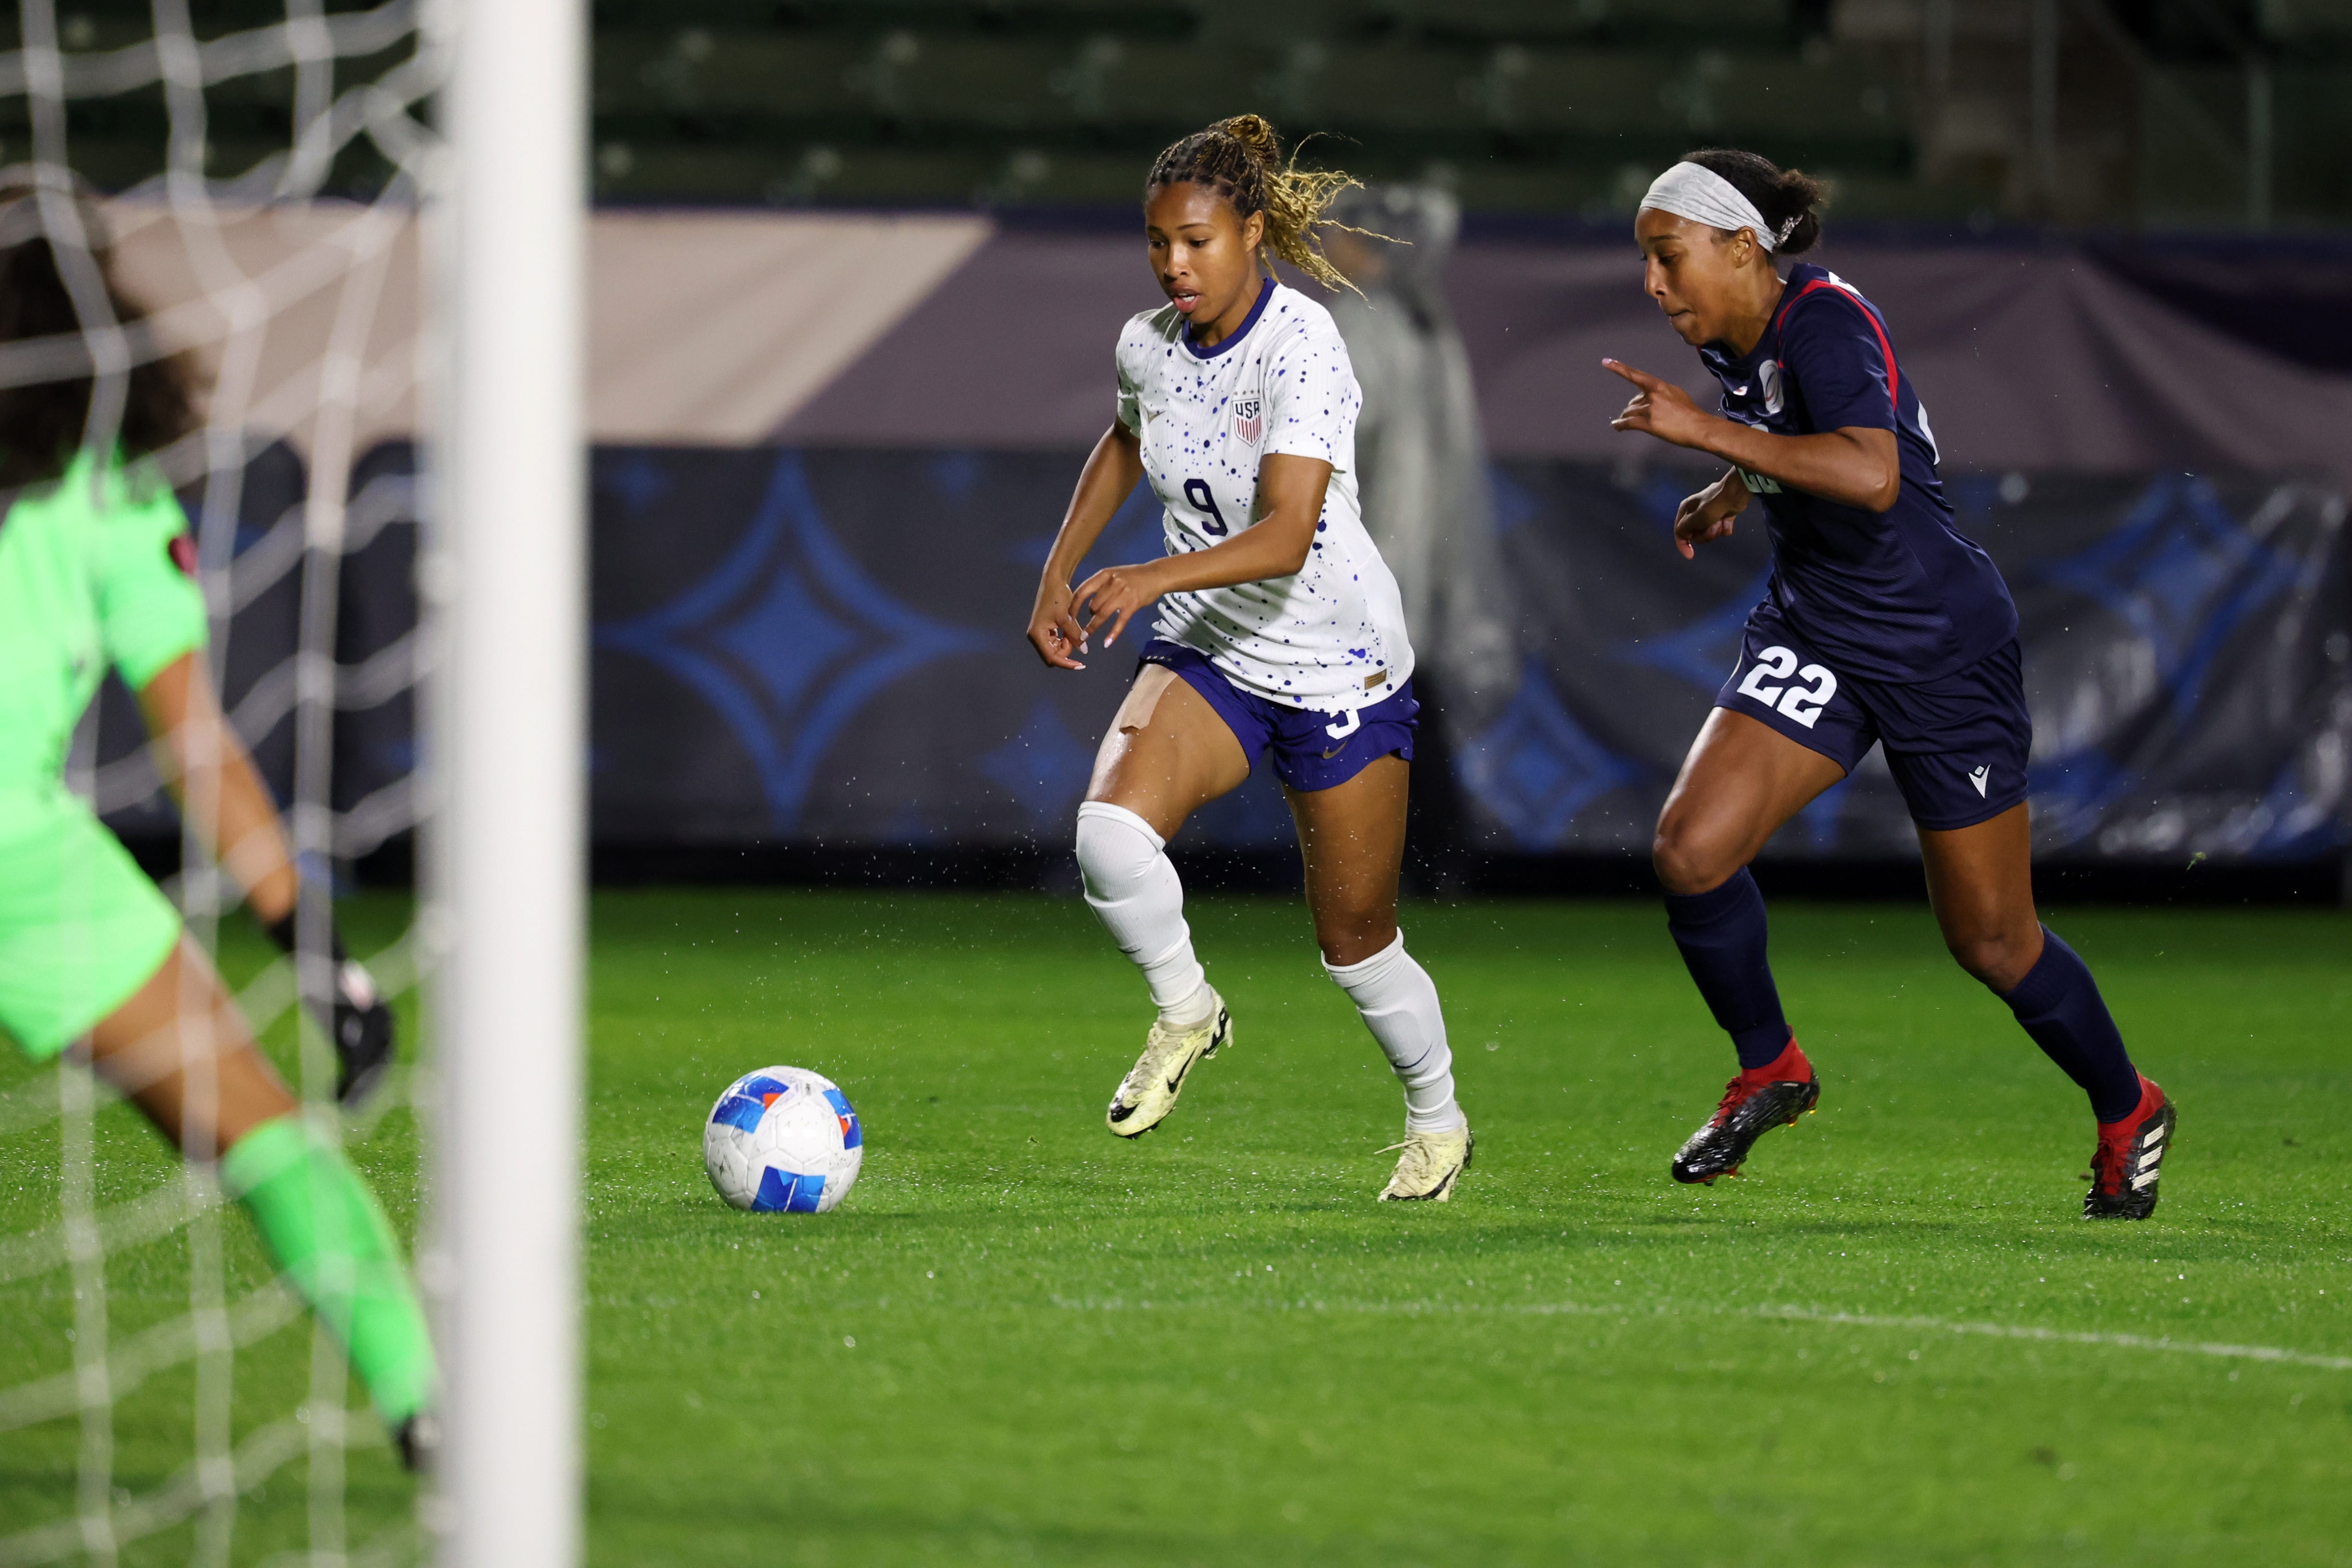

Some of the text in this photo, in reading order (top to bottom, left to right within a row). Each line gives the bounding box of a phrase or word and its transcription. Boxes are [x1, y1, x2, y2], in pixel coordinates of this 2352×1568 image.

[1235, 401, 1259, 419] USA
[1183, 478, 1228, 537] 9
[1736, 646, 1837, 729] 22
